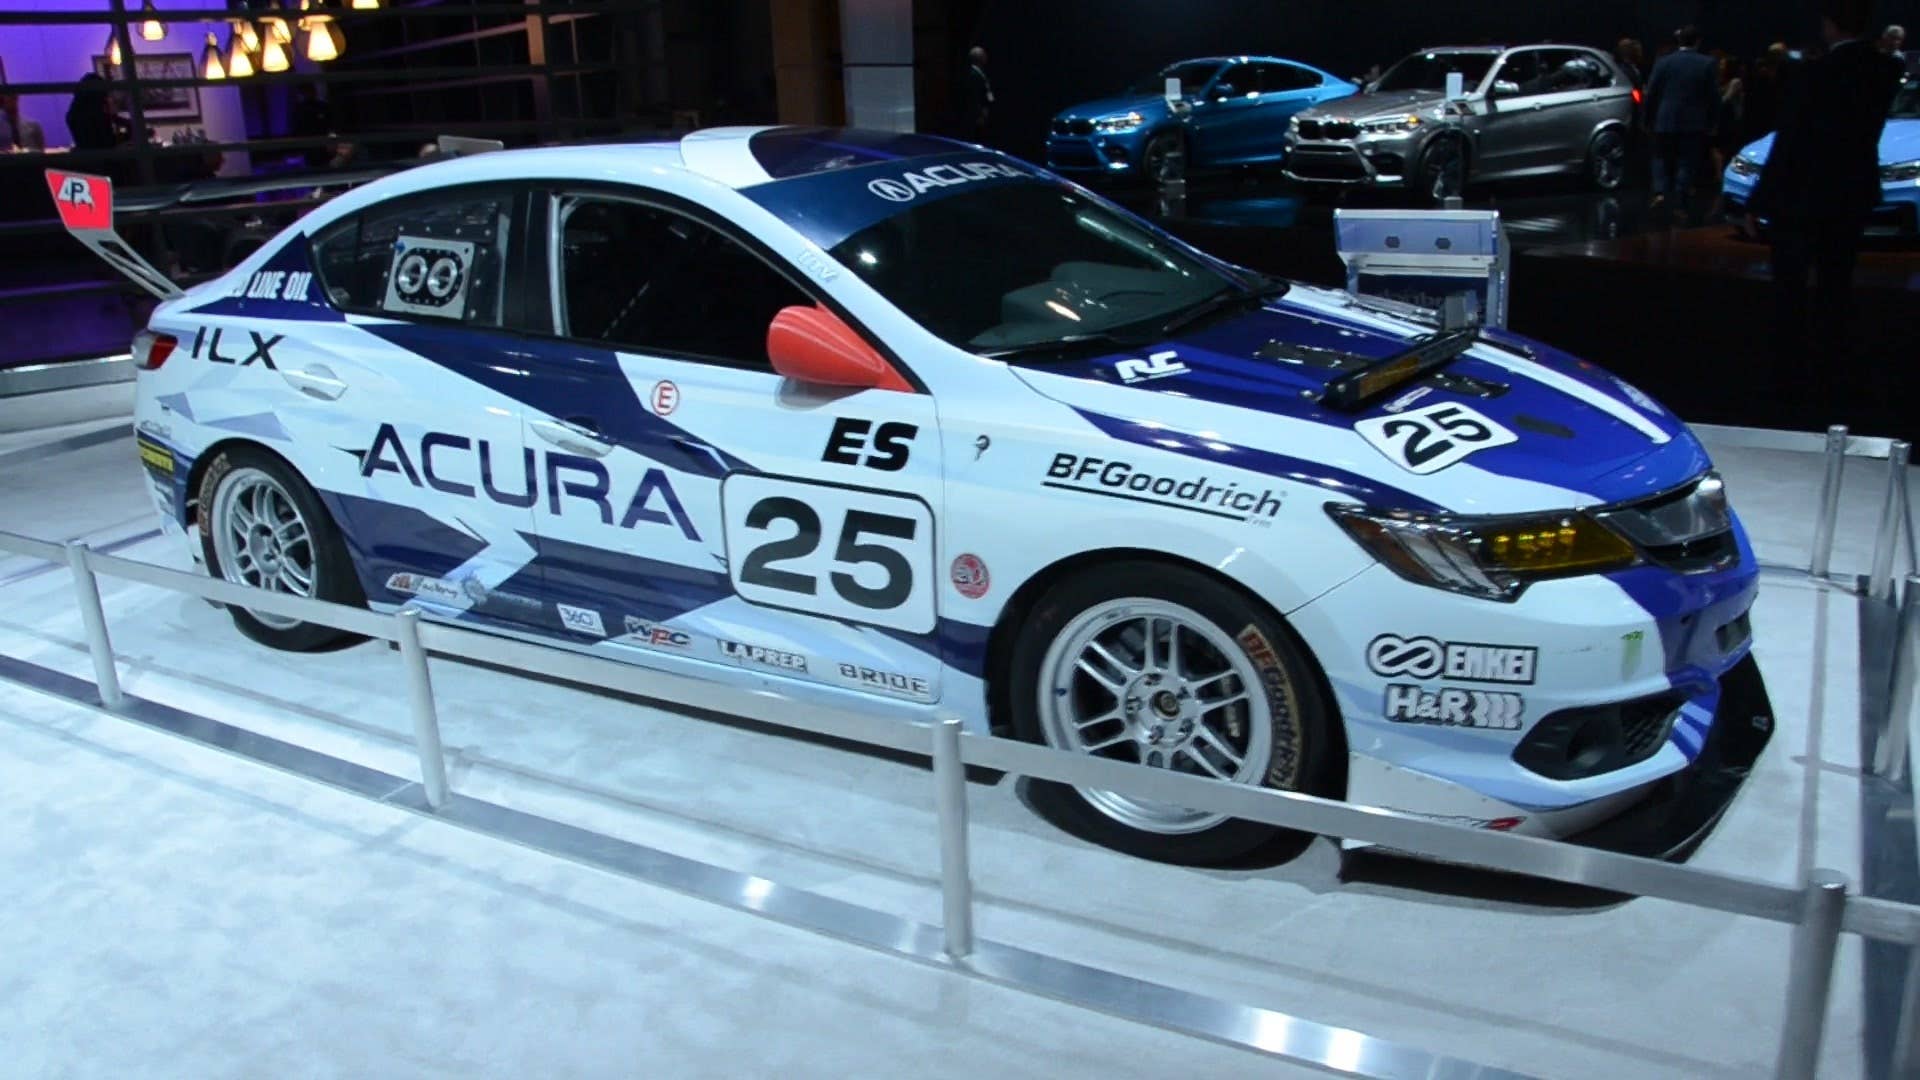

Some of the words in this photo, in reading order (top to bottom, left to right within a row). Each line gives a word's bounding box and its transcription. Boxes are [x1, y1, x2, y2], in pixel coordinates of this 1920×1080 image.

[902, 162, 1035, 194] ACURA
[247, 271, 286, 299] LINE
[282, 271, 312, 301] OIL
[191, 326, 286, 370] ILX
[821, 417, 919, 471] ES
[1383, 407, 1491, 467] 25
[361, 423, 703, 542] ACURA
[1046, 453, 1282, 517] BFGoodrich
[740, 496, 916, 610] 25
[839, 663, 929, 693] BRIDE
[1448, 645, 1535, 681] ENKEI
